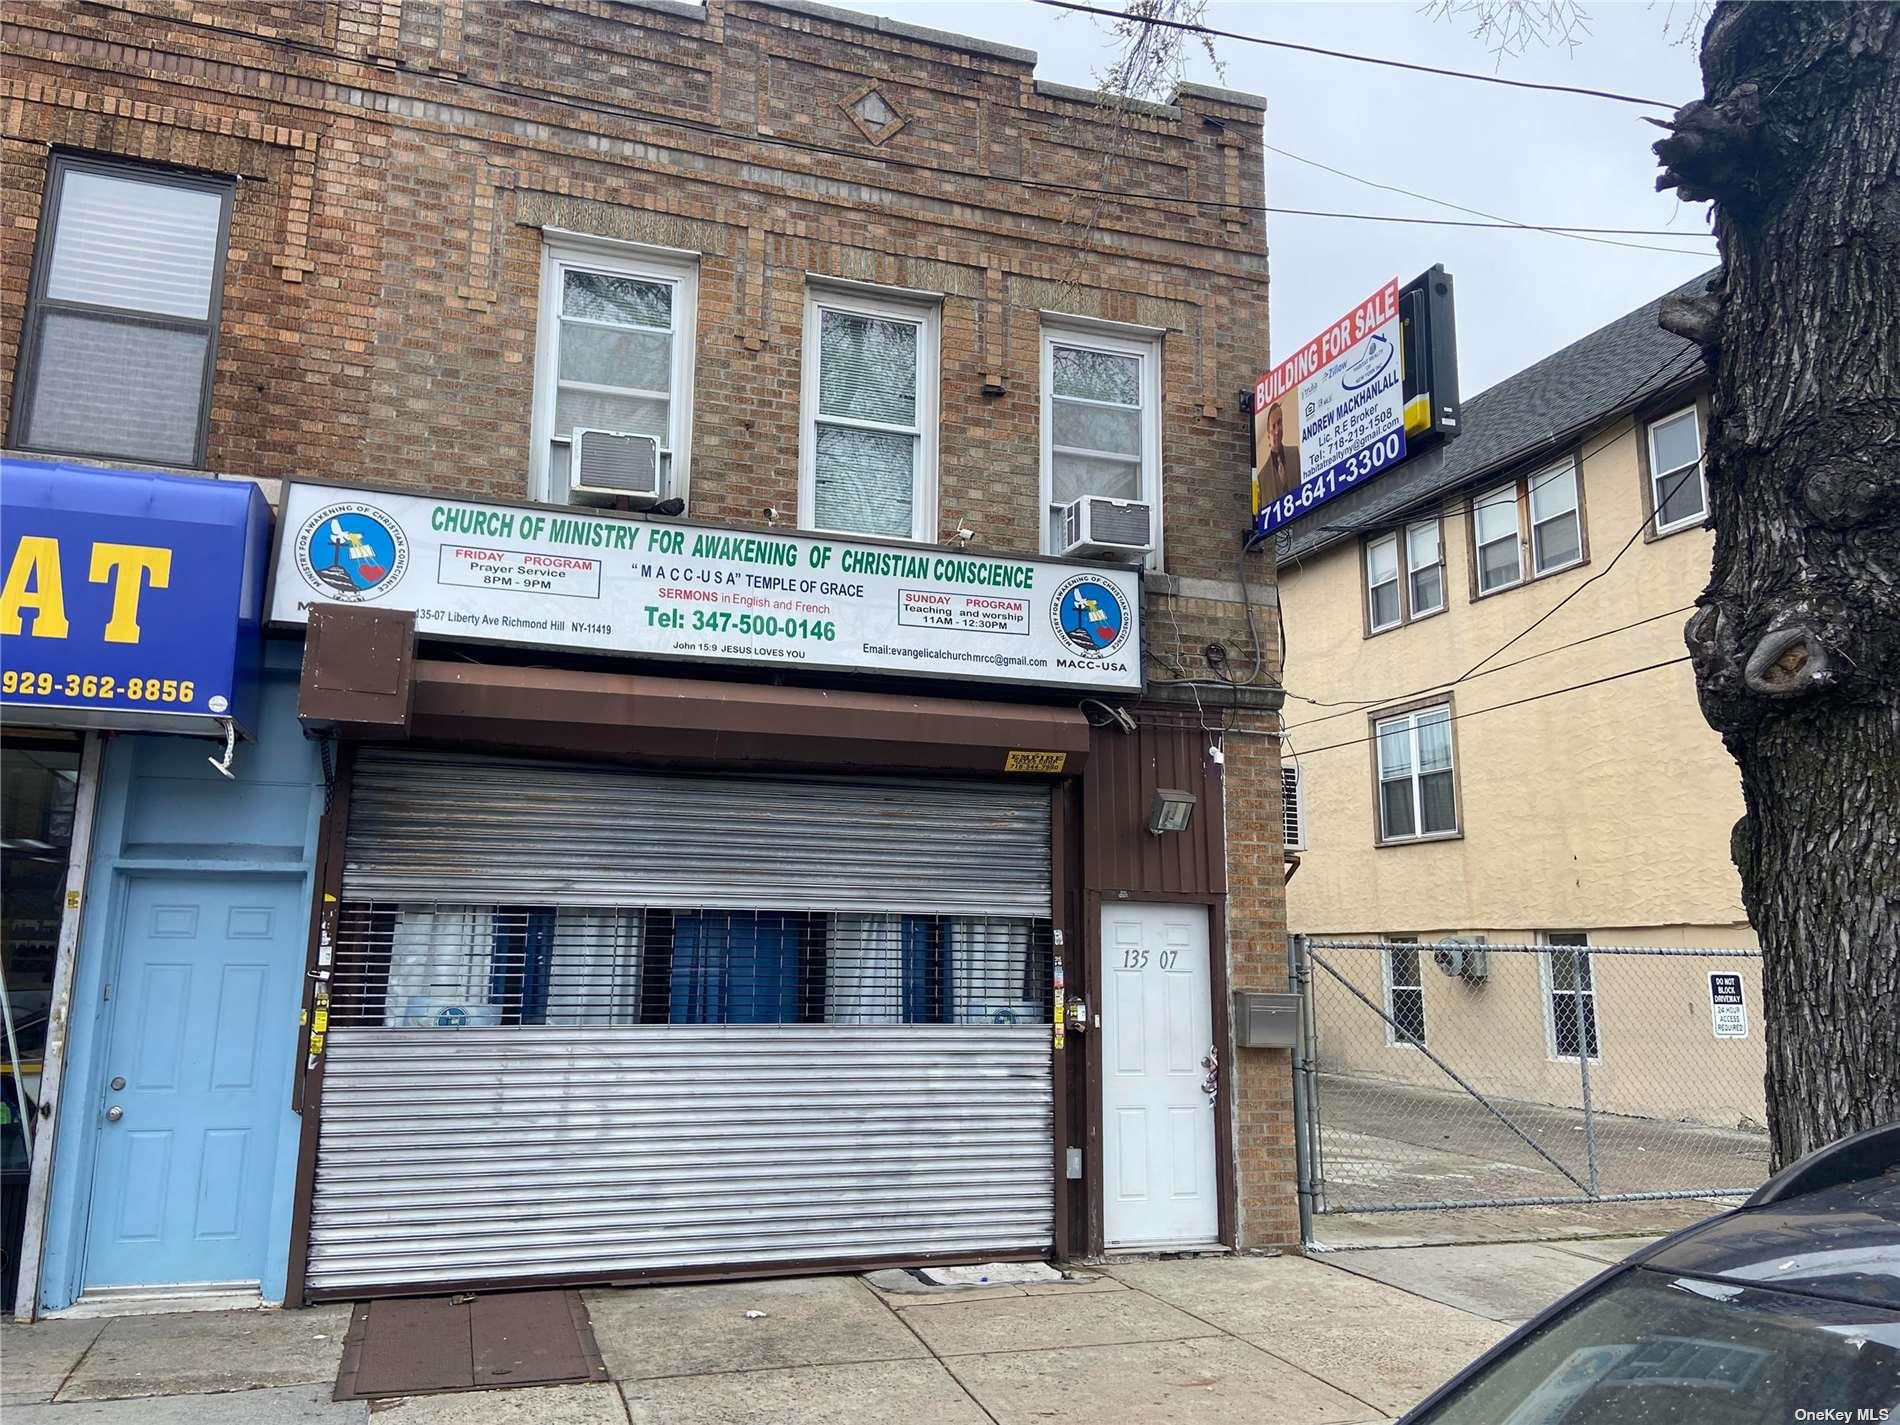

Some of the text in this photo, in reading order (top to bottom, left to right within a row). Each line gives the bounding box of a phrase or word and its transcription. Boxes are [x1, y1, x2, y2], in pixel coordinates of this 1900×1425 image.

[1256, 284, 1395, 413] BUILDING FOR SALE
[1301, 369, 1399, 443] ANDREW MACKHANLALL
[1309, 408, 1392, 465] Tel: 718-219-1508
[1318, 404, 1378, 447] Lic. R.E Broker
[1303, 417, 1400, 480] habitatrealtyny@gmail.com
[1261, 433, 1400, 530] 718-641-3300
[299, 505, 406, 592] MINISTRY FOR AWAKENING OF CHRISTIAN CONSCIENCE
[431, 506, 1034, 589] CHURCH OF MINISTRY FOR AWAKENING OF CHRISTIAN CONSCIENCE
[455, 549, 593, 571] FRIDAY PROGRAM
[470, 562, 566, 578] Prayer Service
[483, 575, 512, 586] 8PM
[524, 578, 551, 589] 9PM
[1091, 576, 1101, 584] OF
[746, 574, 796, 592] TEMPLE
[800, 580, 817, 594] OF
[820, 582, 864, 598] GRACE
[1057, 575, 1089, 602] AWAKENING
[1102, 580, 1127, 609] CHRISTIAN
[658, 587, 830, 615] SERMONS in English and French
[903, 603, 1024, 622] Teaching and worship
[905, 593, 1023, 611] SUNDAY PROGRAM
[416, 608, 612, 635] 135-07 Liberty Ave Richmond Hill NY-11419
[644, 606, 836, 641] Tel: 347-500-0146
[923, 616, 953, 626] 11AM
[962, 619, 1008, 630] 12:30PM
[1052, 617, 1072, 647] MINISTRY
[1111, 612, 1129, 650] CONSCIENCE
[672, 641, 806, 659] John 15:9 JESUS LOVES YOU
[1056, 659, 1127, 672] MACC-USA
[2, 671, 195, 702] 929-362-8856
[1123, 949, 1178, 969] 135 07
[1714, 995, 1740, 1003] DRIVEWAY
